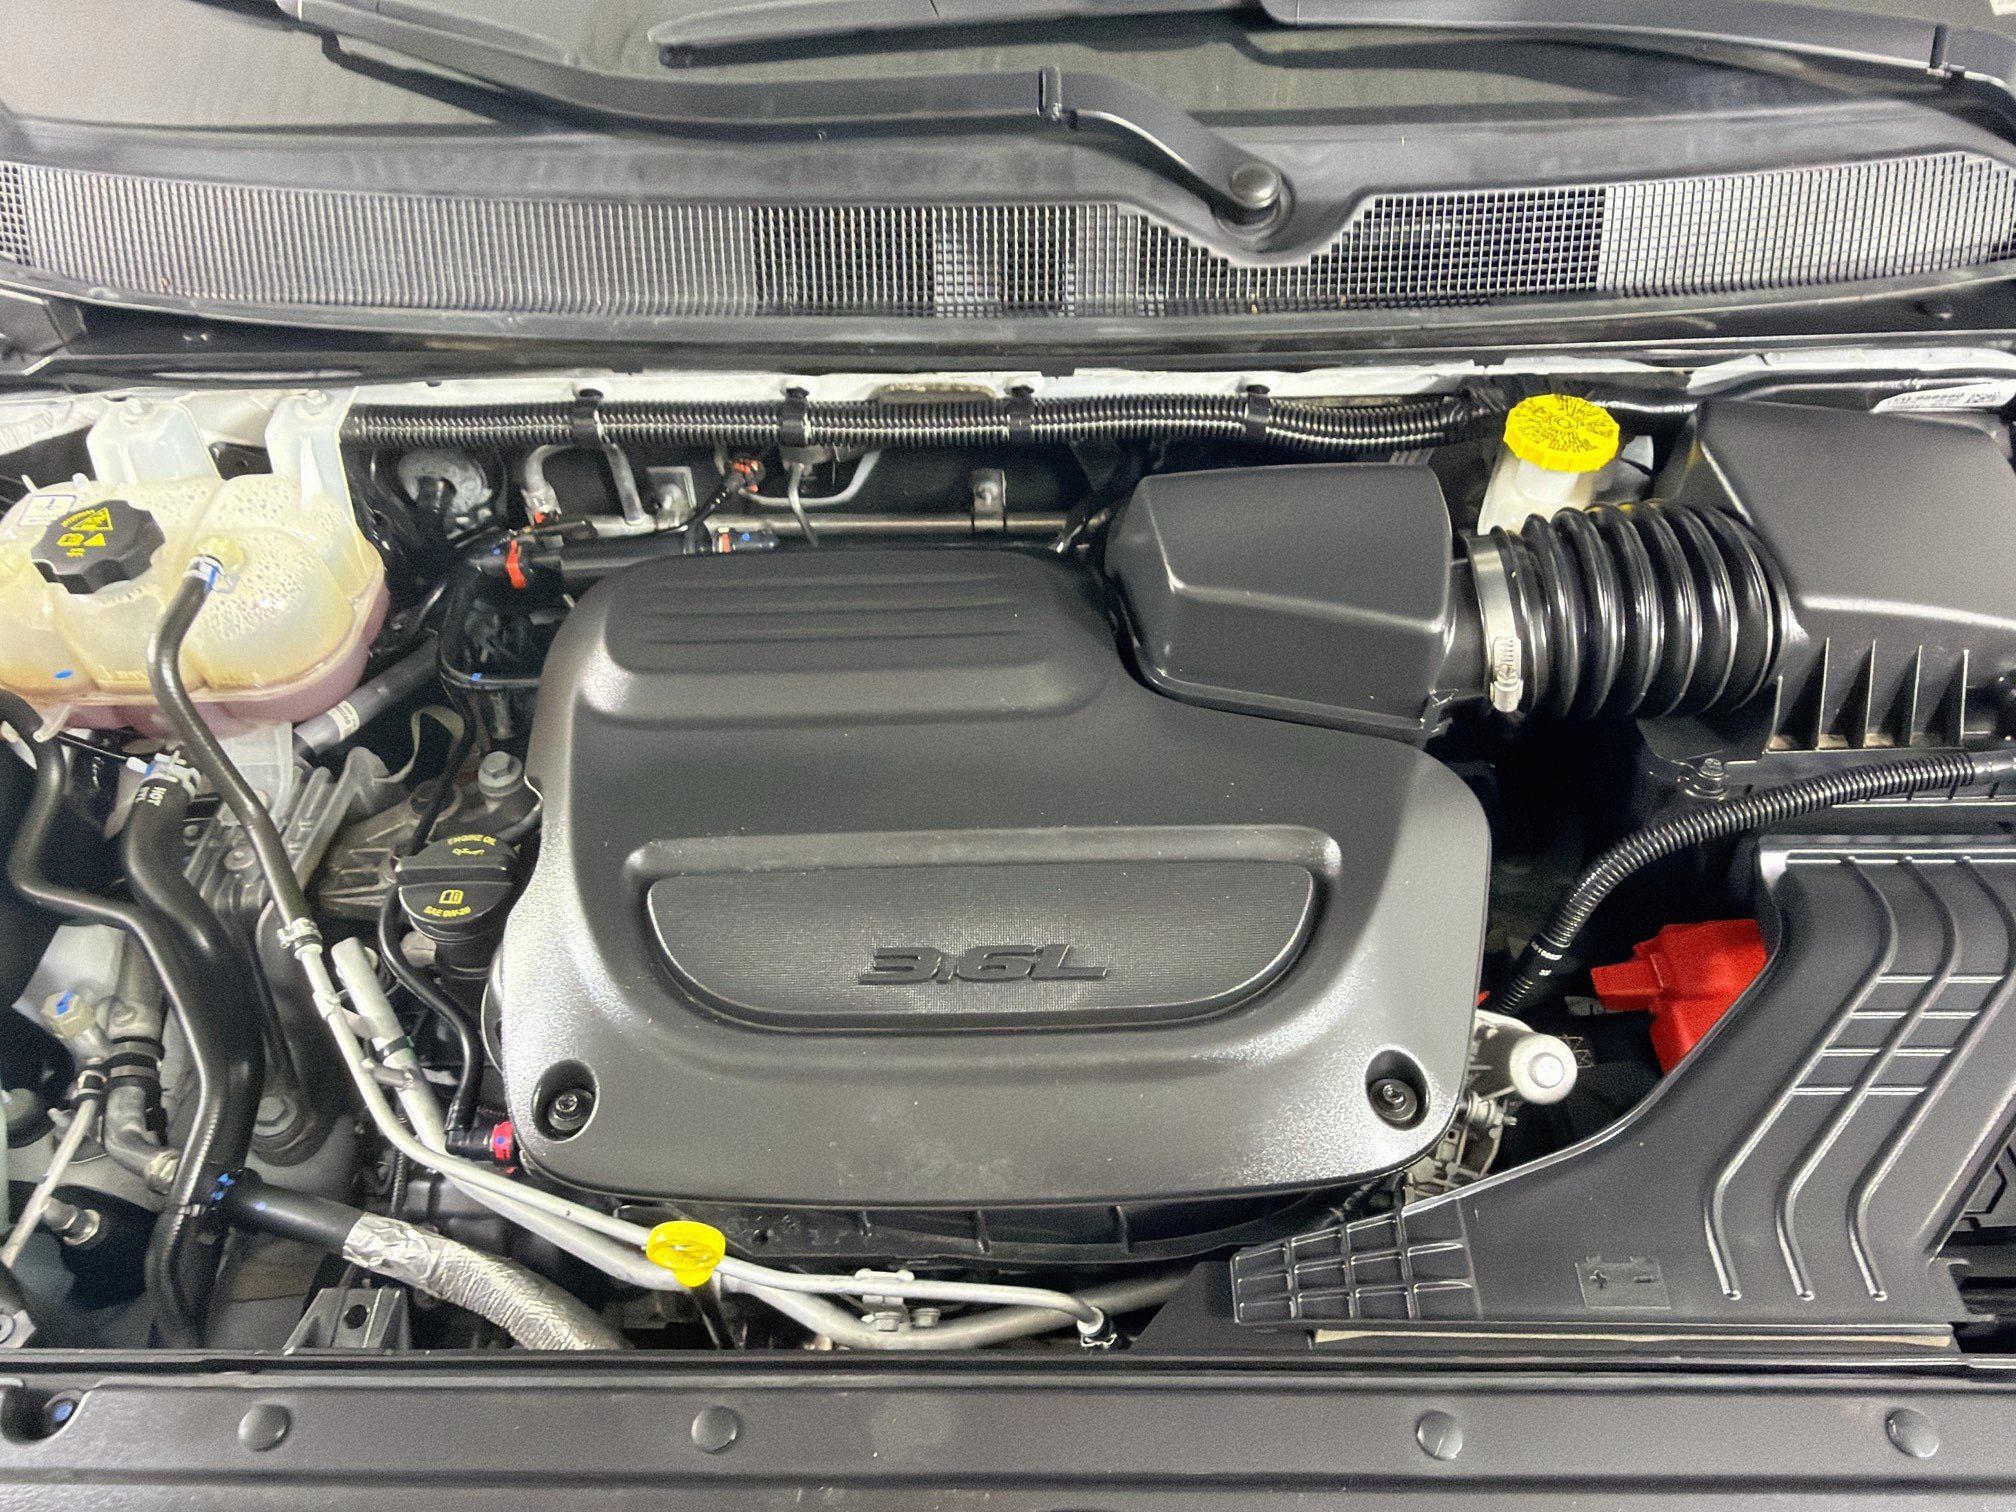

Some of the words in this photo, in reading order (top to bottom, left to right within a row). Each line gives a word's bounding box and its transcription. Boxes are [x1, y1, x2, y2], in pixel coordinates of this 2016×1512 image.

[147, 786, 168, 807] HOT
[448, 834, 484, 845] ENGINE
[483, 835, 497, 846] OIL
[424, 905, 442, 917] SAE
[442, 906, 471, 918] 0W-20
[858, 943, 1108, 985] 3.6L
